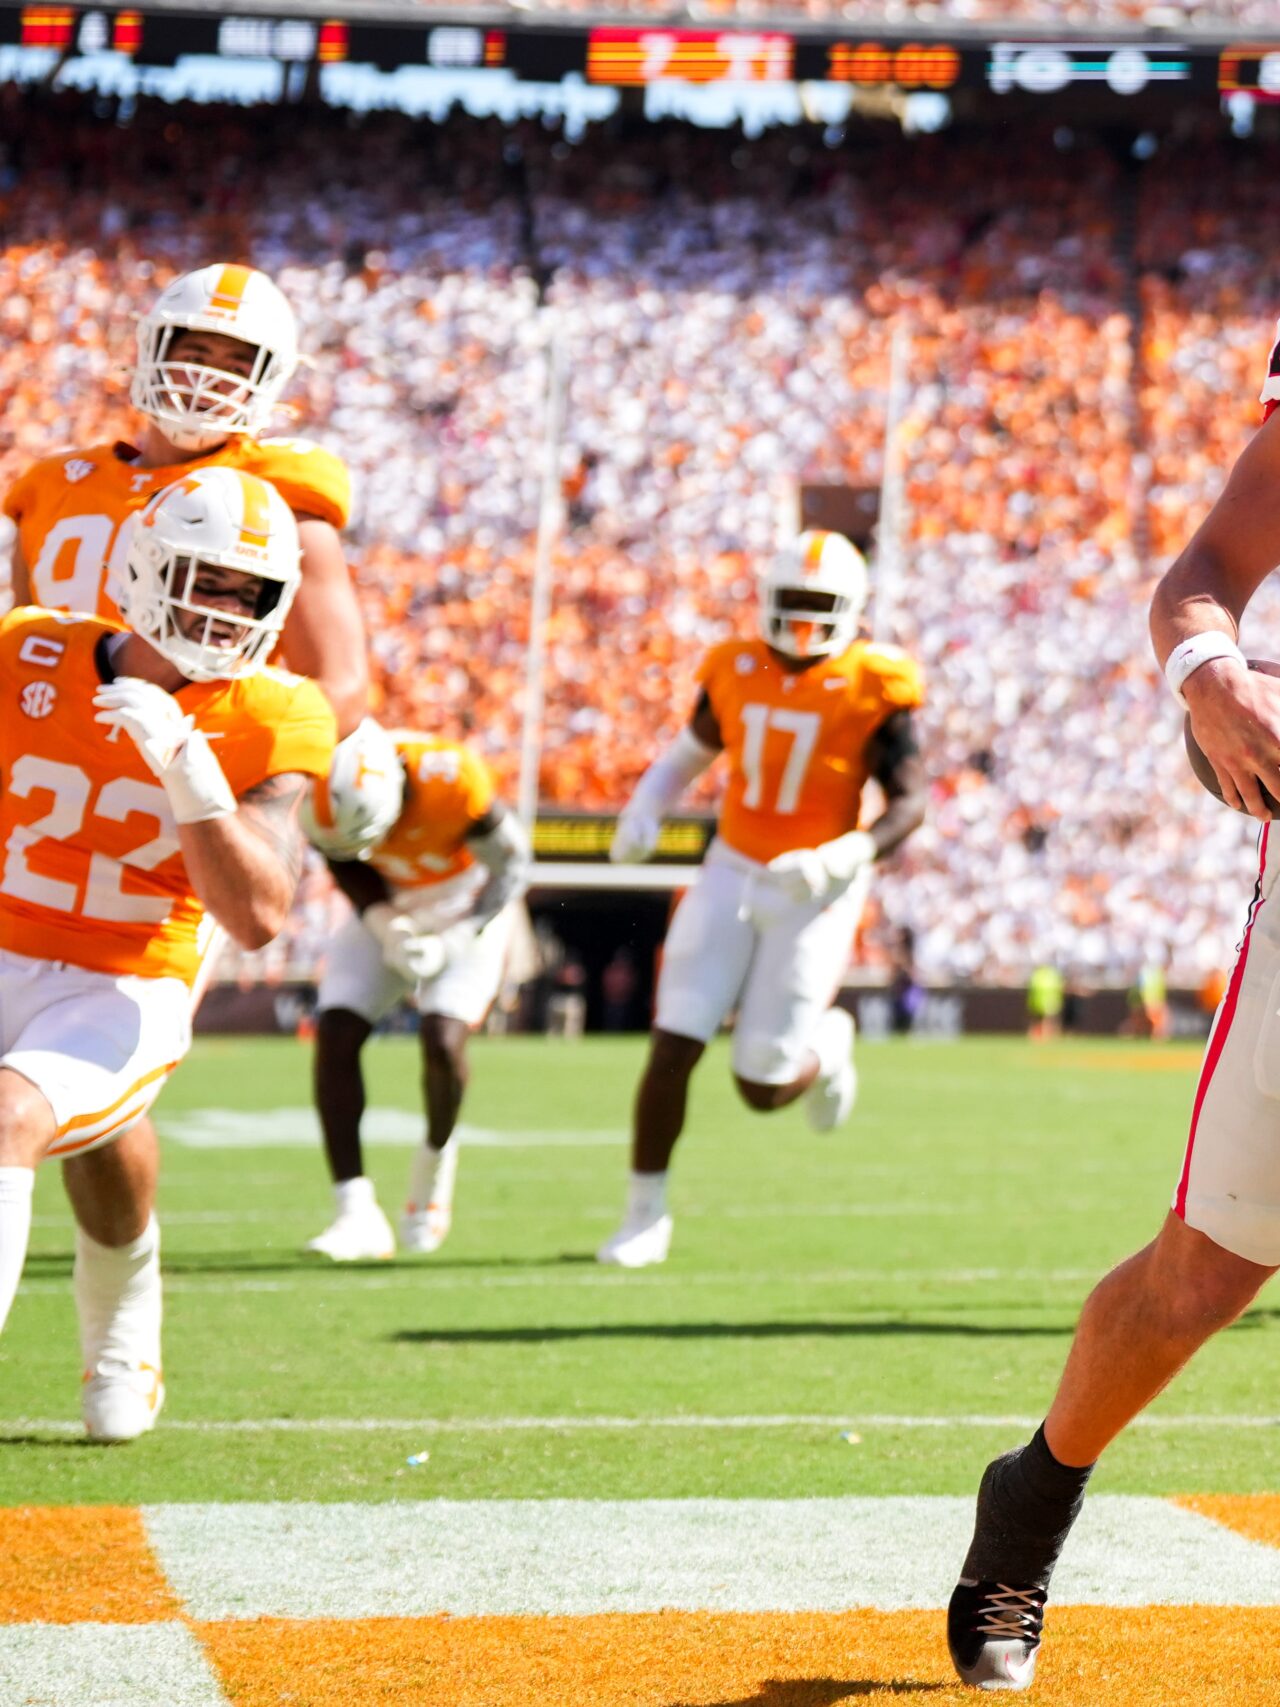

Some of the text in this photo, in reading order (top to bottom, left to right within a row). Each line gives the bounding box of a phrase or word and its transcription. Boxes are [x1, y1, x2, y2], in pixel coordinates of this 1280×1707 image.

[19, 636, 64, 667] C
[20, 681, 57, 719] SEC
[740, 702, 822, 815] 17
[0, 754, 181, 925] 22
